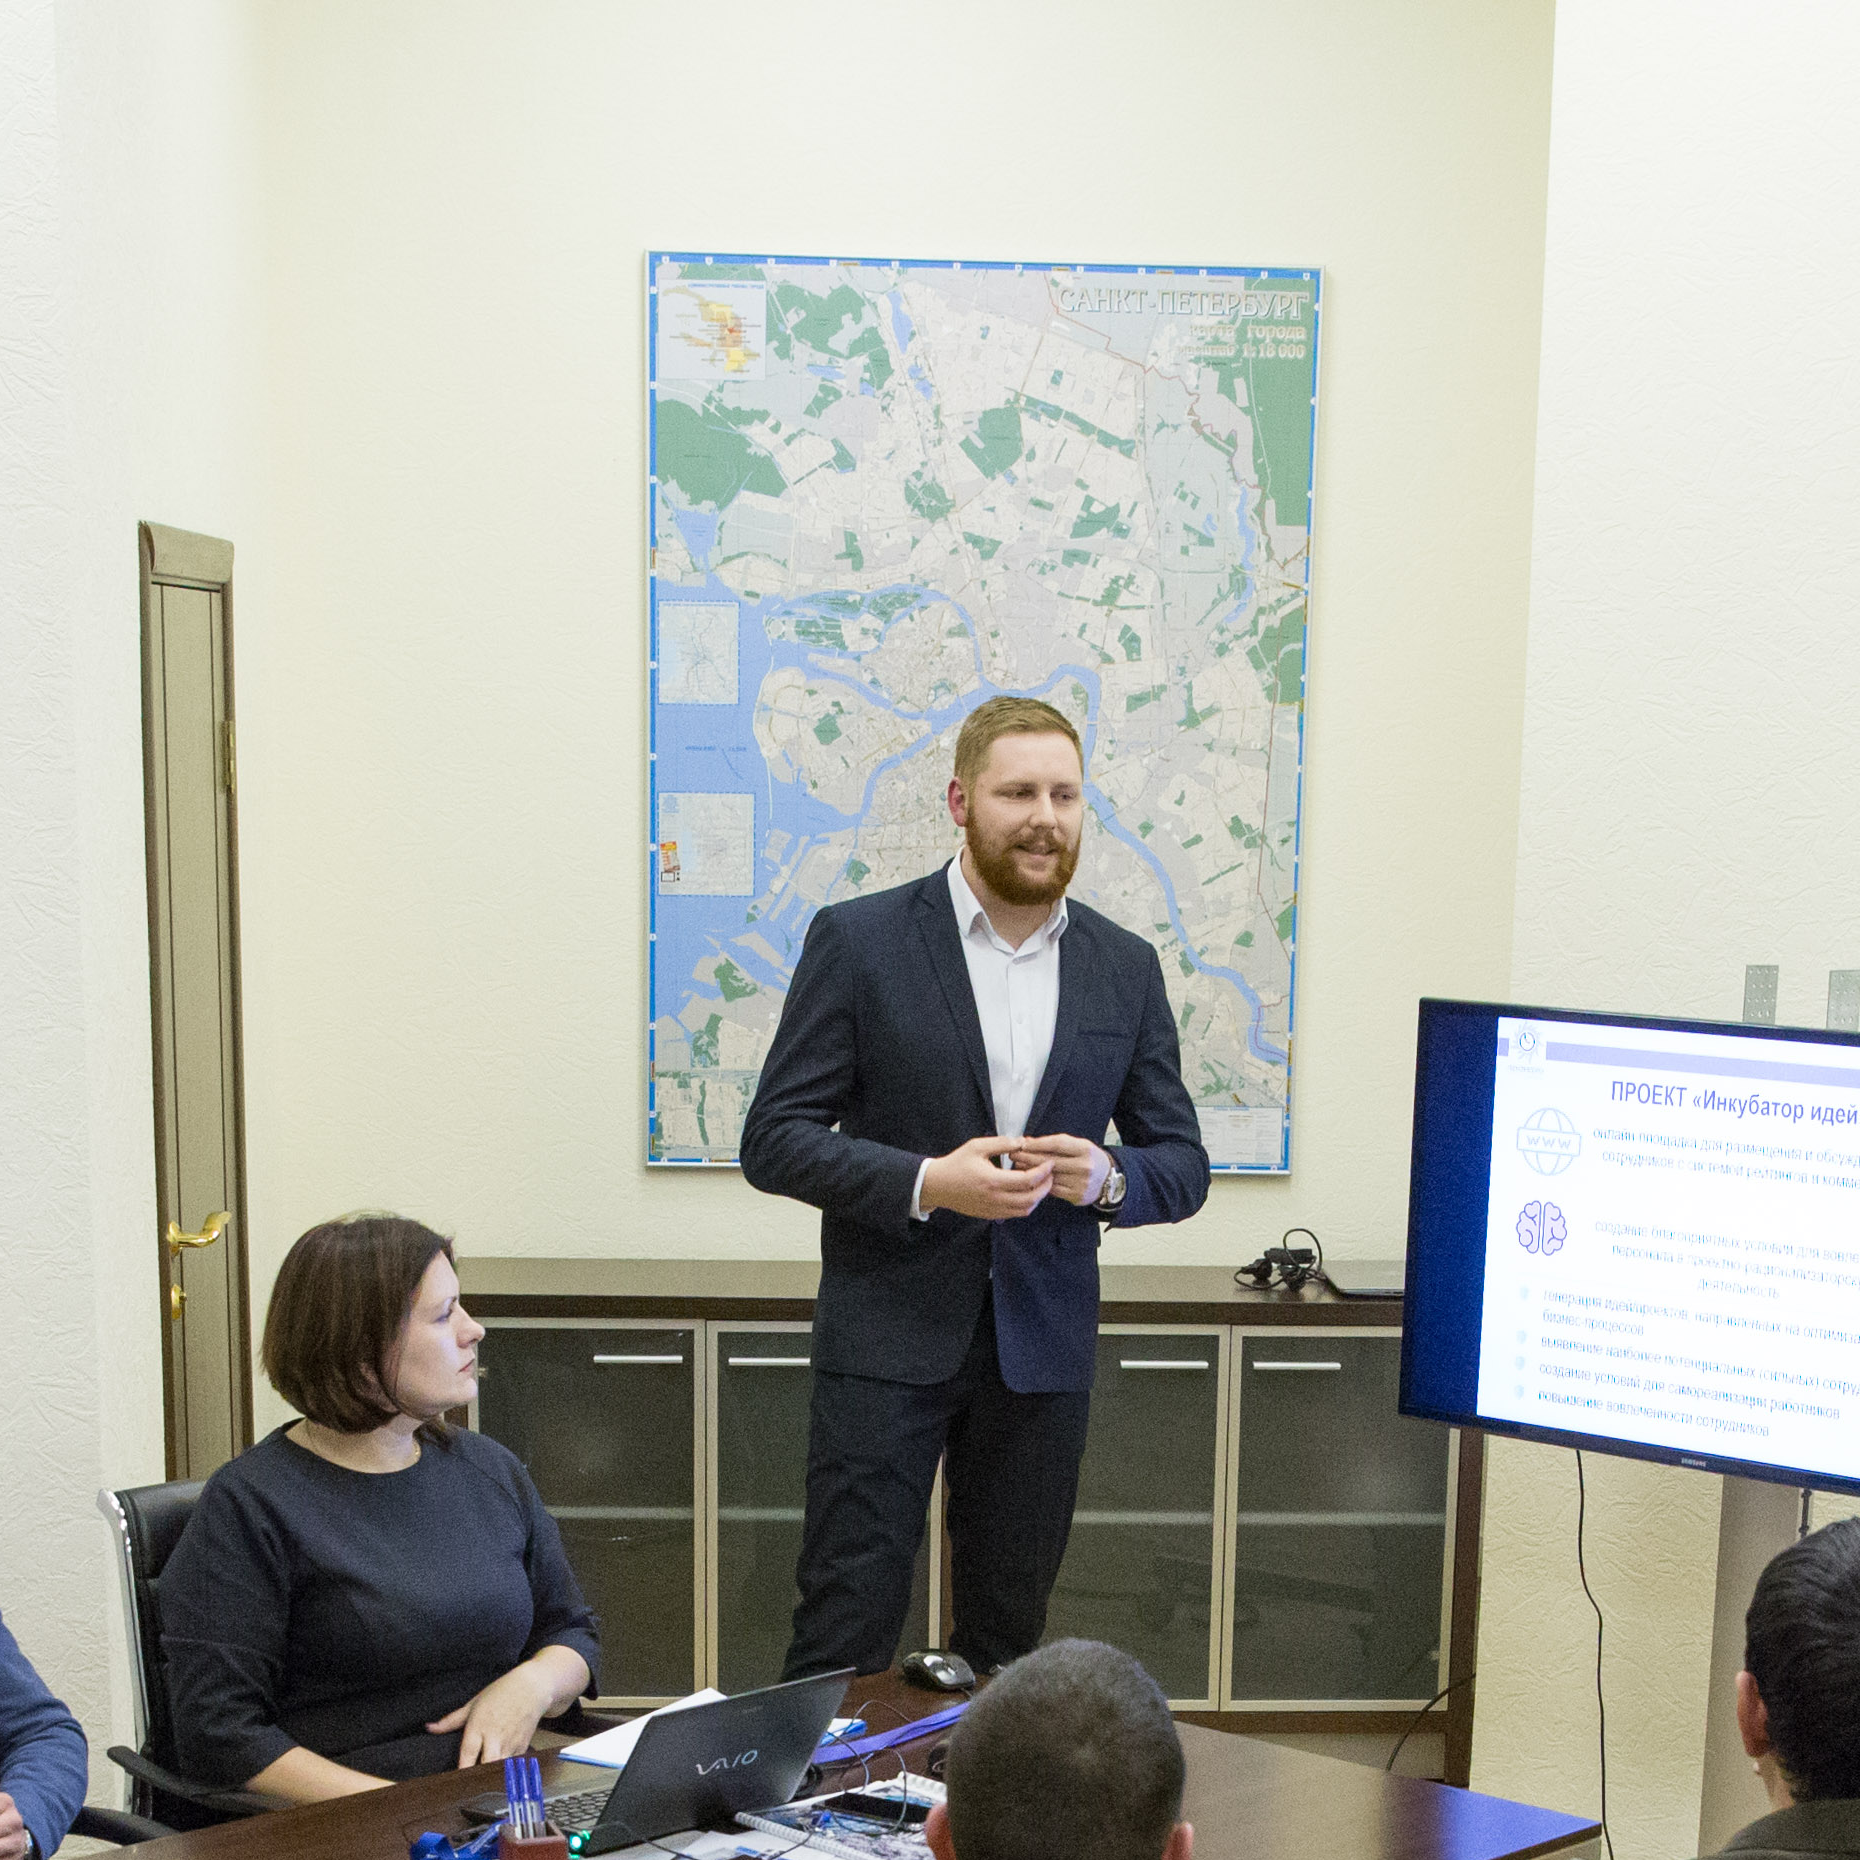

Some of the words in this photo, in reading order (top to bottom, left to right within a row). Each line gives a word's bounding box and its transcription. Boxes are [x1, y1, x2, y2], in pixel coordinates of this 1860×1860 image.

[1057, 287, 1309, 320] САНКТ-ПЕТЕРБУРГ
[1247, 325, 1306, 343] города
[1611, 1080, 1687, 1107] ПРОЕКТ
[1693, 1089, 1804, 1124] «Инкубатор
[695, 1749, 758, 1775] VAIO
